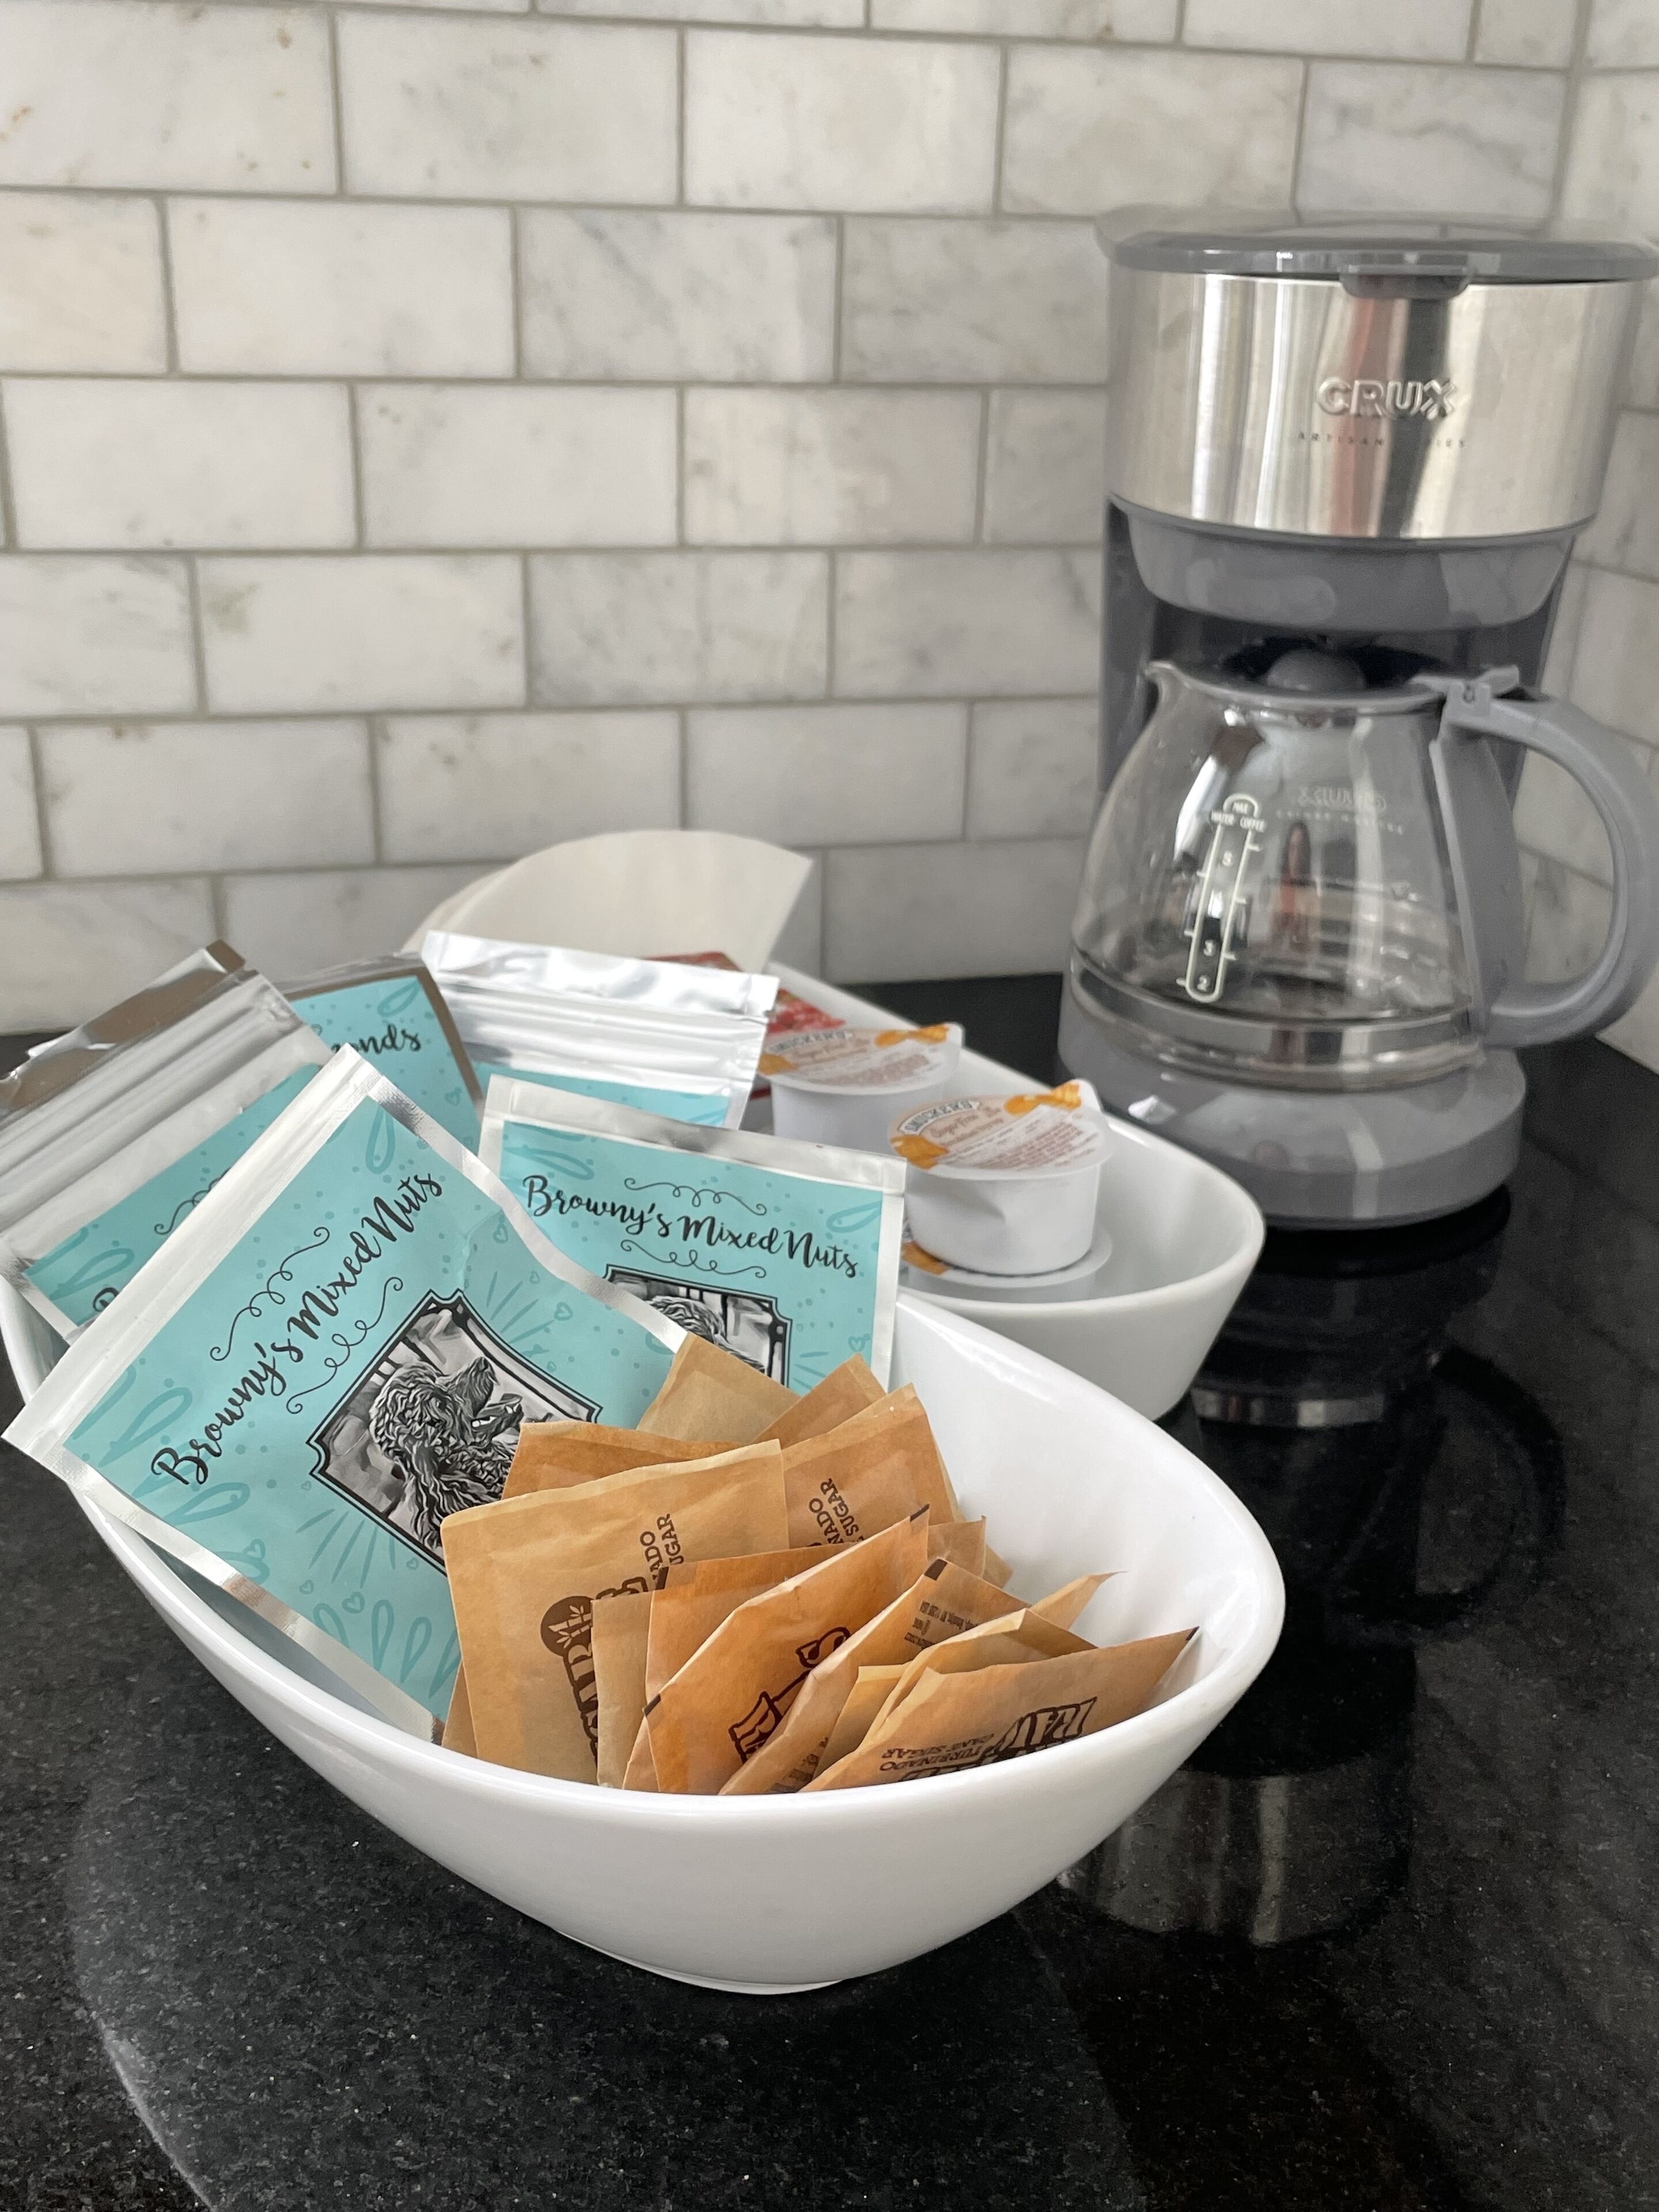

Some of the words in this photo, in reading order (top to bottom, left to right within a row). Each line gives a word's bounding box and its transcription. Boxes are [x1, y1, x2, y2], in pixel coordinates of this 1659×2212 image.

[1316, 377, 1456, 421] CRUX
[1203, 939, 1215, 957] 3
[1196, 975, 1210, 992] 2
[522, 1174, 673, 1238] Browny's
[676, 1215, 783, 1255] Mixed
[783, 1229, 858, 1278] Nuts
[150, 1338, 304, 1486] Browny's
[287, 1231, 382, 1340] Mixed
[361, 1173, 442, 1243] Nuts
[820, 1478, 859, 1537] SUGAR
[881, 1745, 946, 1759] SUGAR
